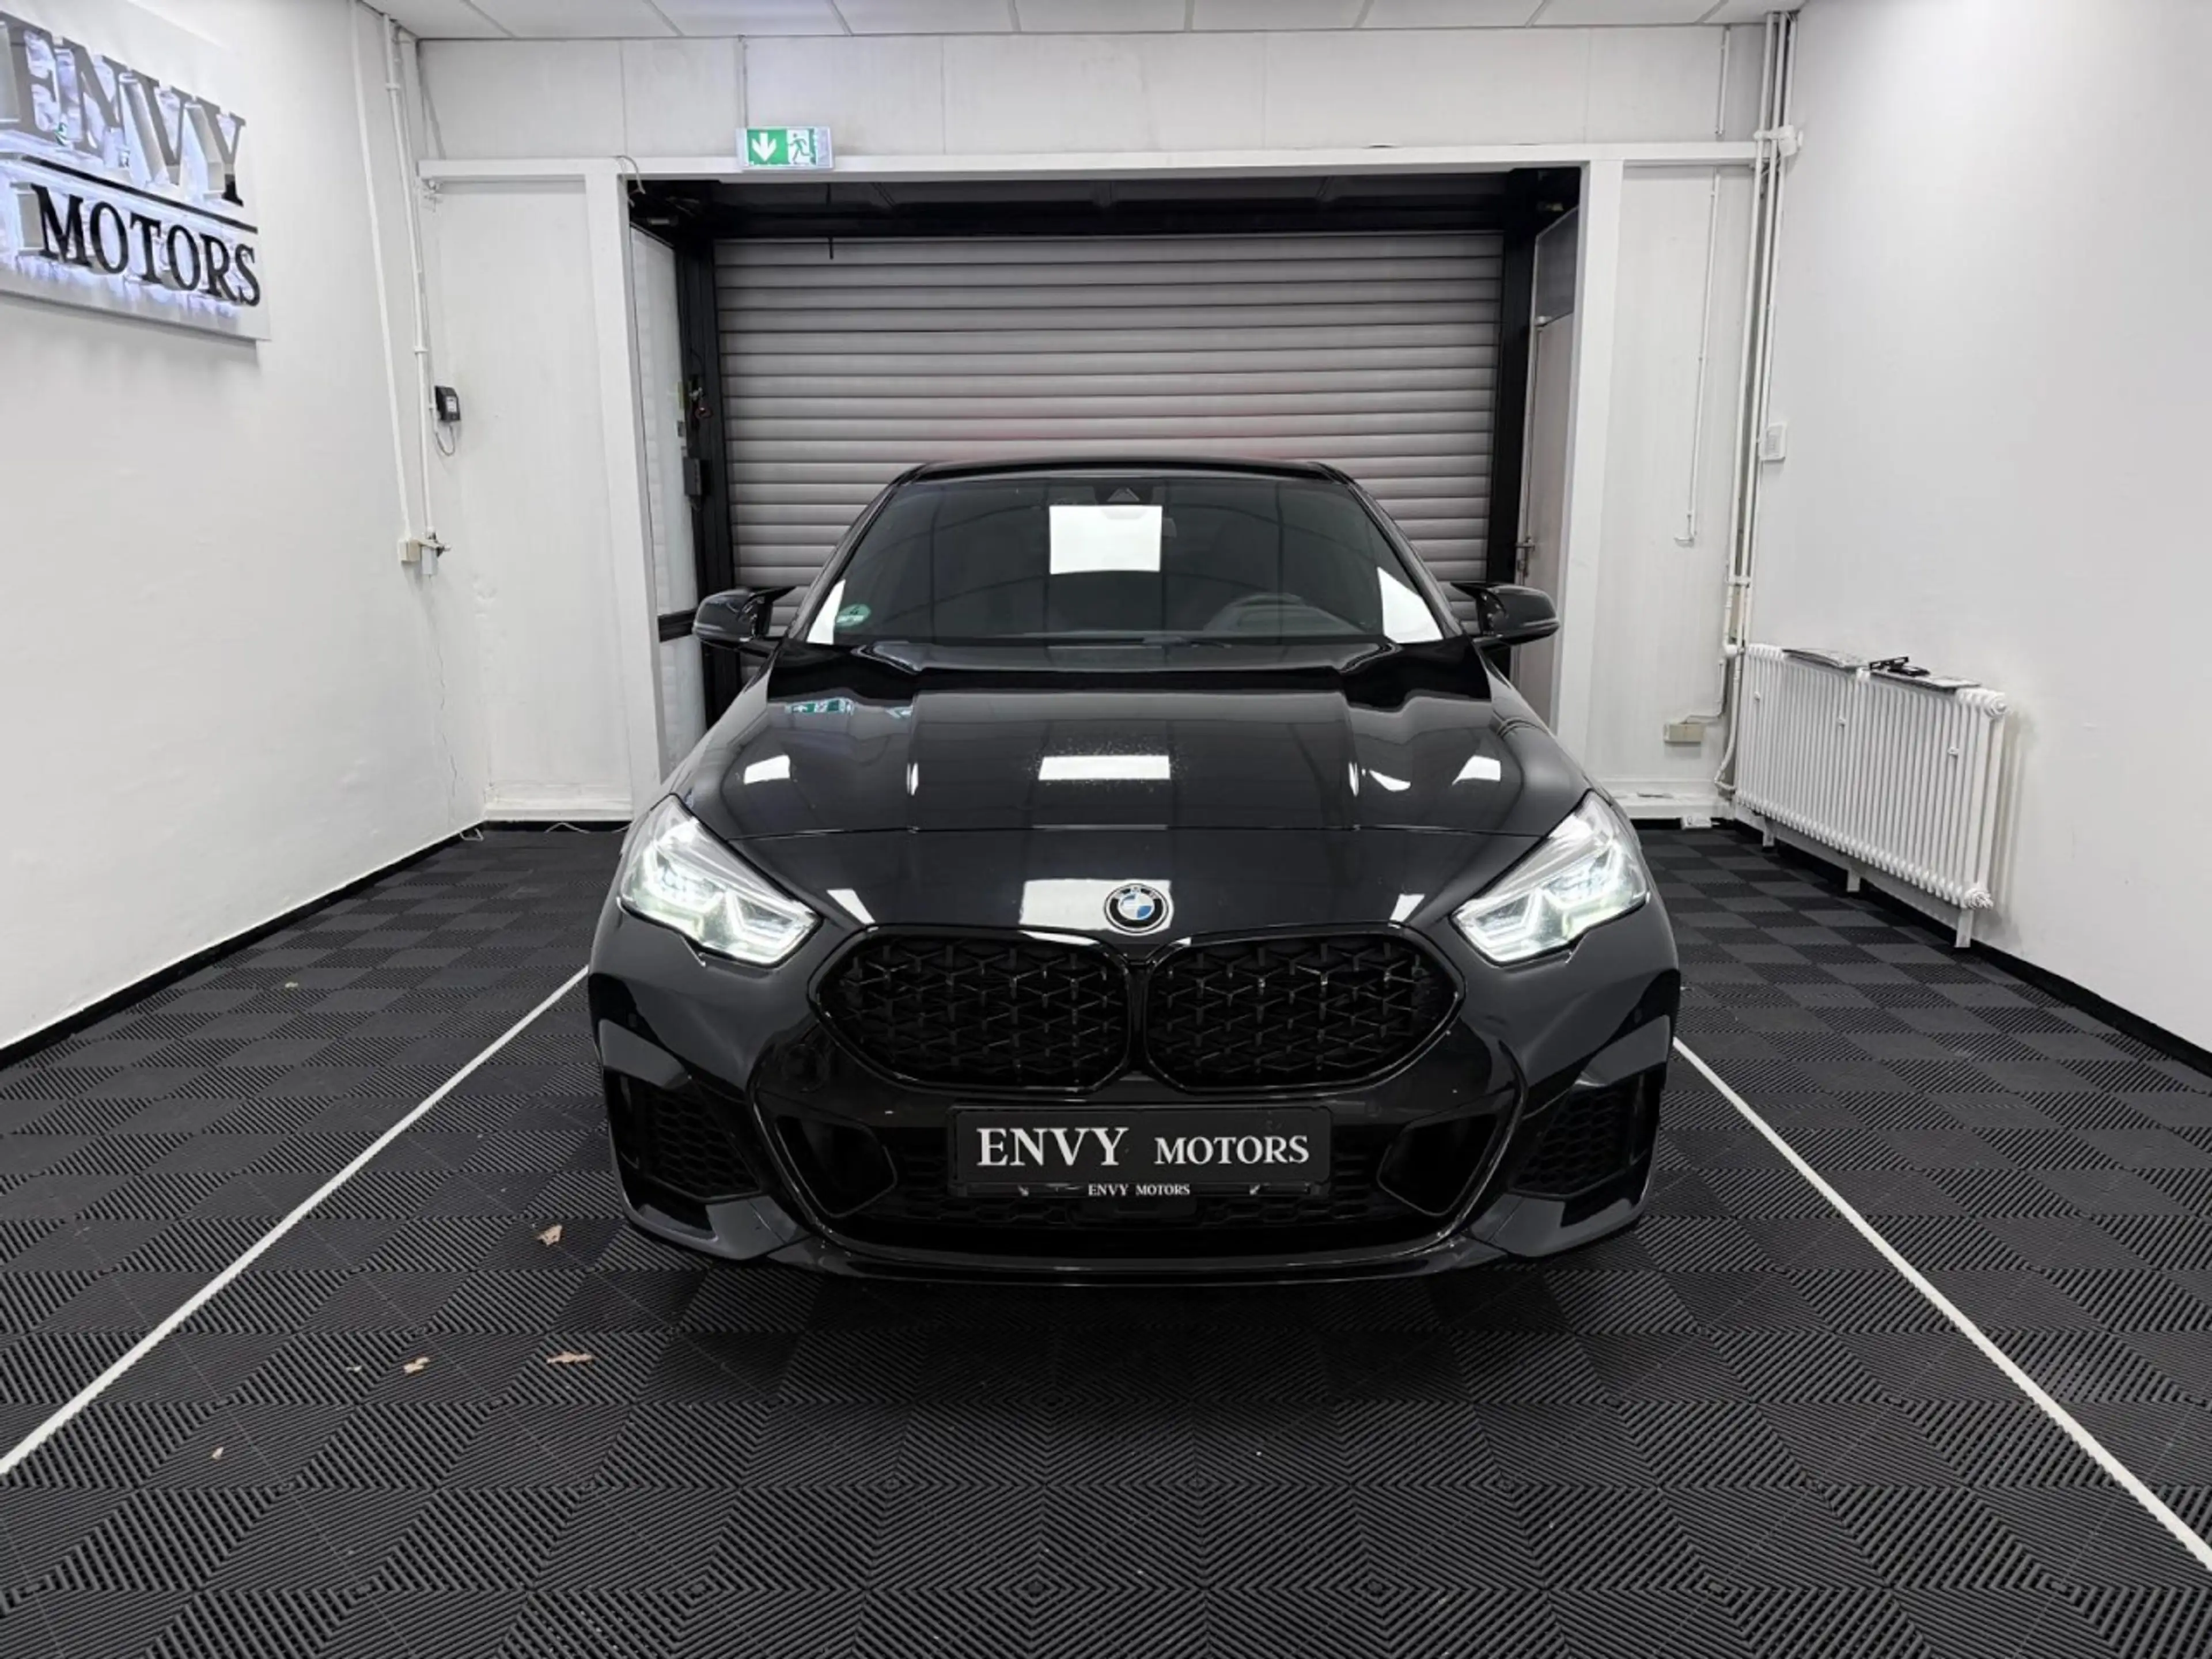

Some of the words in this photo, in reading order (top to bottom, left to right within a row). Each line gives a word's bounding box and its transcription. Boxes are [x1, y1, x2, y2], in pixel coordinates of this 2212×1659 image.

[0, 10, 246, 207] ENVY
[30, 183, 261, 306] MOTORS
[976, 1127, 1129, 1166] ENVY
[1154, 1135, 1310, 1165] MOTORS
[1088, 1183, 1129, 1196] ENVY
[1135, 1183, 1191, 1196] MOTORS
